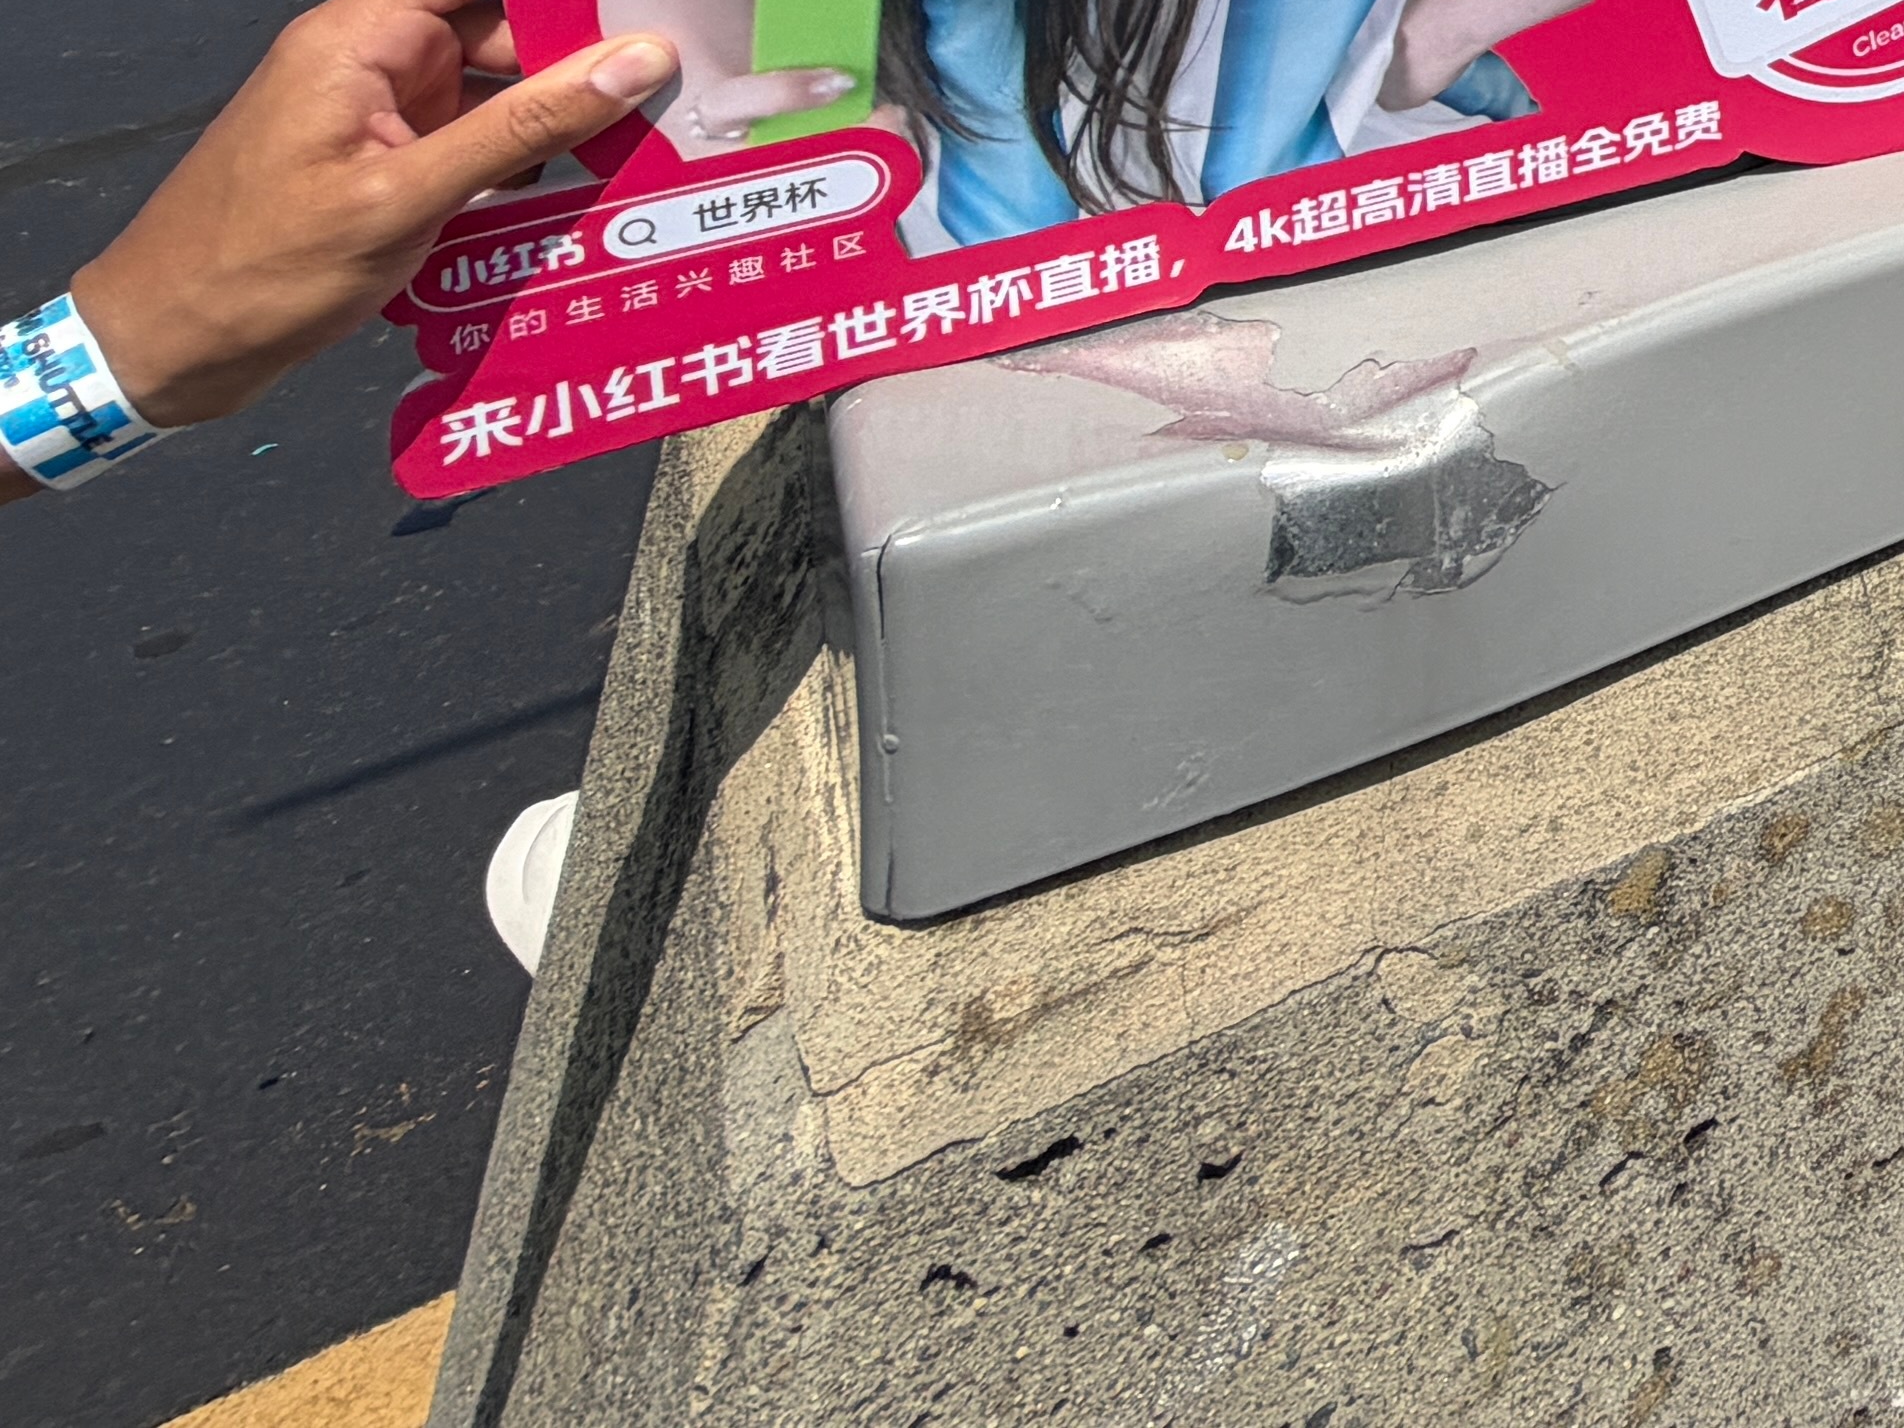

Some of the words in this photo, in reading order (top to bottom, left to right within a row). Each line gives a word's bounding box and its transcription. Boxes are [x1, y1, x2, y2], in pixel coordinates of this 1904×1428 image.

[440, 230, 586, 293] 小红书
[692, 176, 829, 234] 世界杯
[1224, 100, 1722, 254] 4k超高清直播全免费
[449, 231, 867, 355] 你的生活兴趣社区
